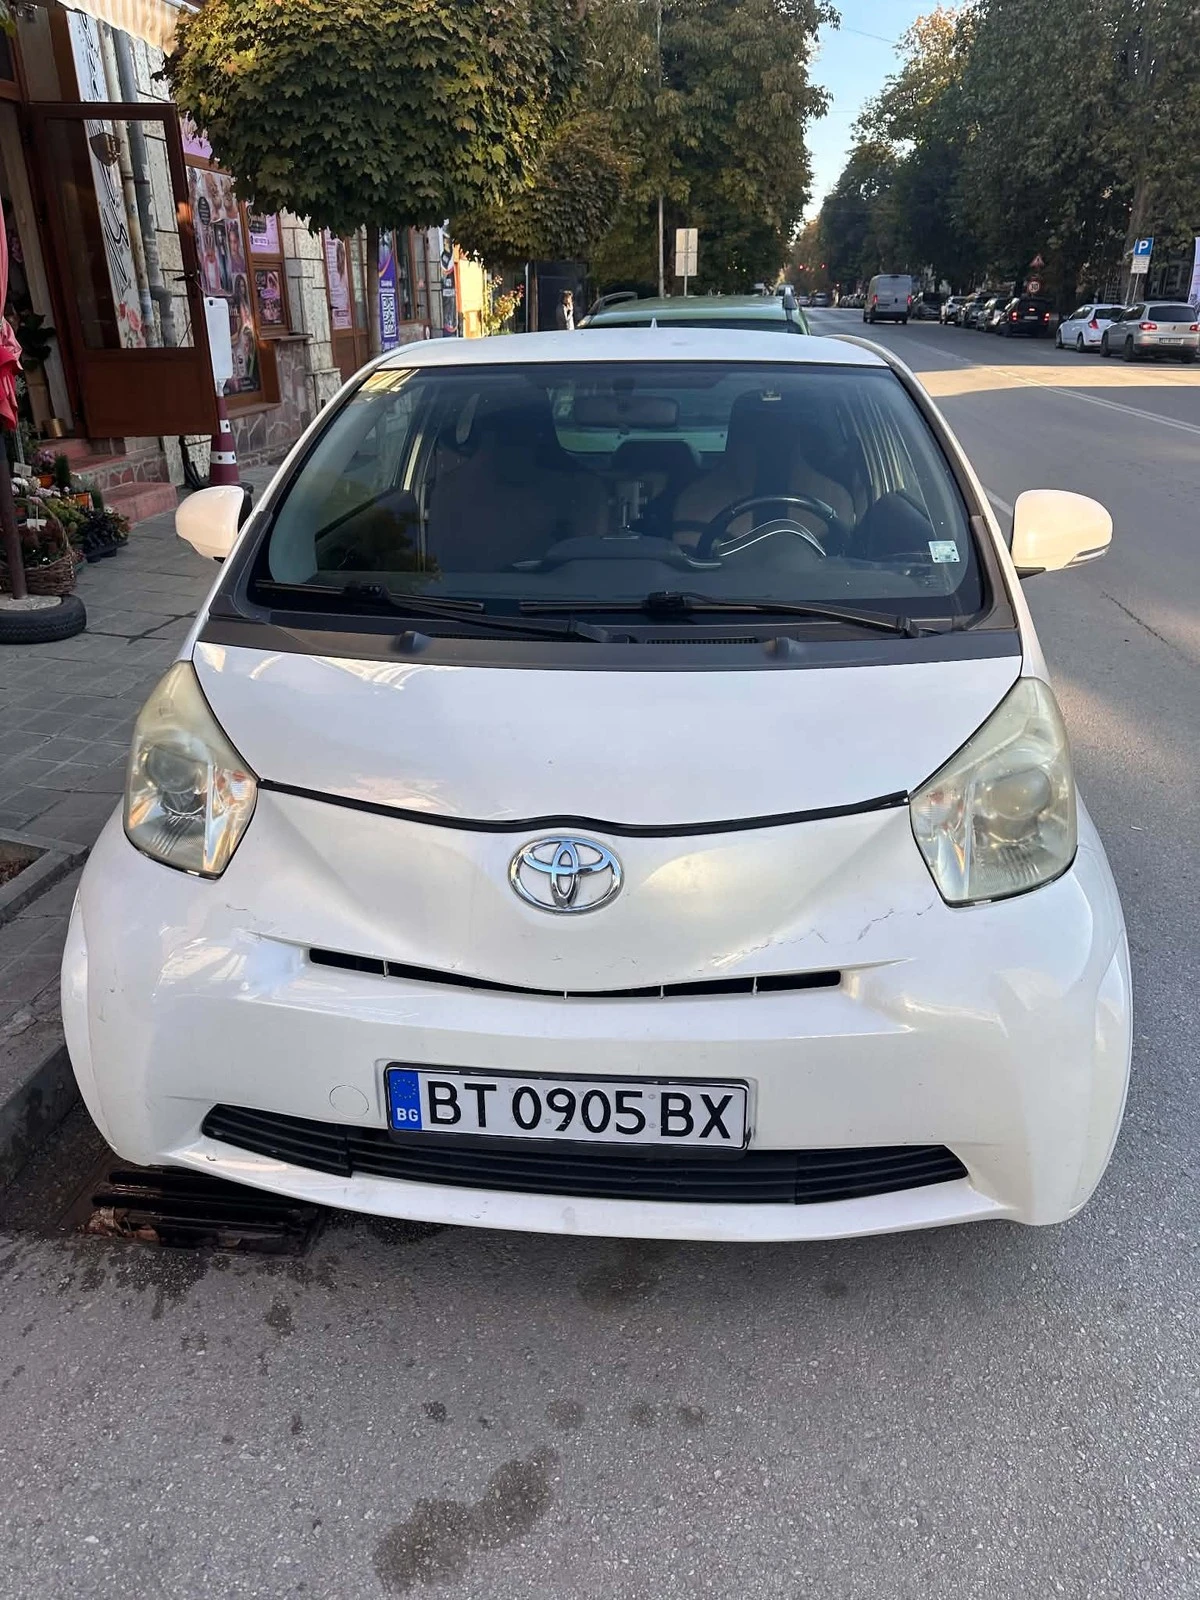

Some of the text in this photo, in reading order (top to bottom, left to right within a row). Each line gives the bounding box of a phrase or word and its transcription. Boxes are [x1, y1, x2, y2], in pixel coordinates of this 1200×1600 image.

[1138, 240, 1149, 253] P
[396, 1107, 419, 1122] BG
[427, 1080, 734, 1140] BT 0905 BX
